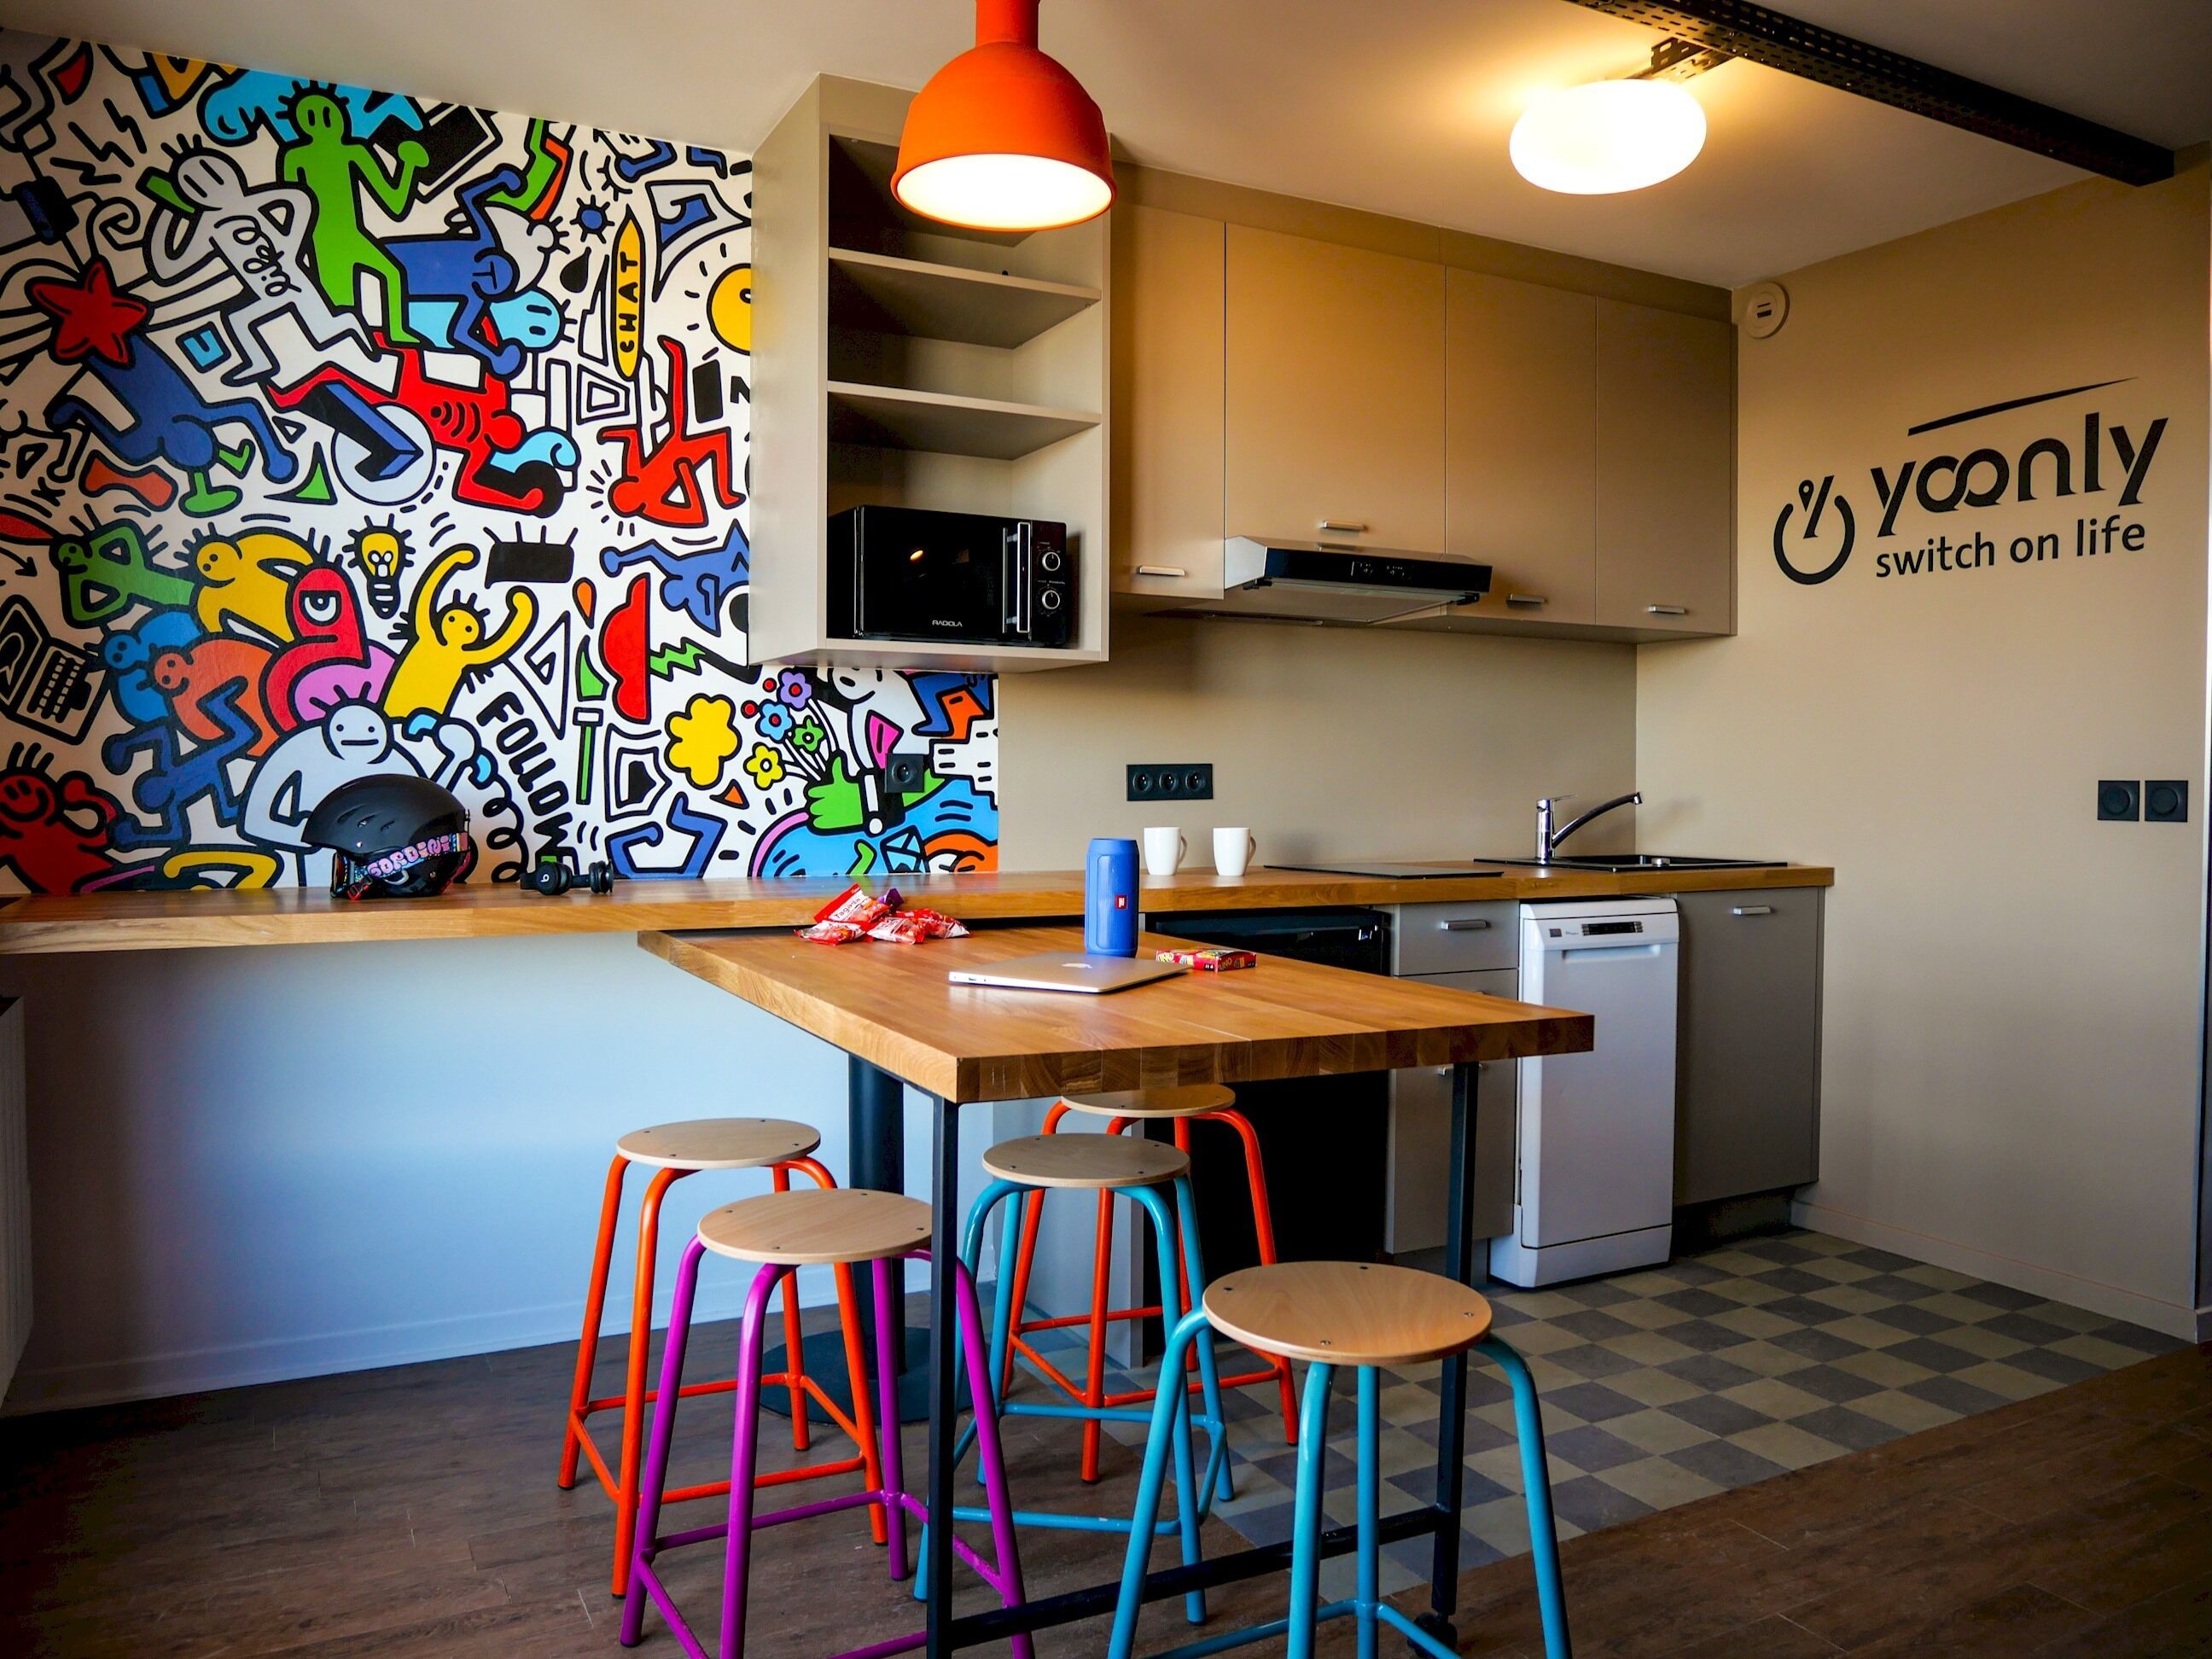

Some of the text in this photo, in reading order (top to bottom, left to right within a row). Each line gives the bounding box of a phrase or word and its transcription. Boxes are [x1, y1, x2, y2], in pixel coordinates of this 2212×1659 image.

[213, 214, 303, 298] life
[618, 251, 638, 353] CHAT
[1870, 411, 2169, 538] yoonly
[1876, 514, 2145, 578] switch on life
[475, 691, 574, 857] FOLLOW
